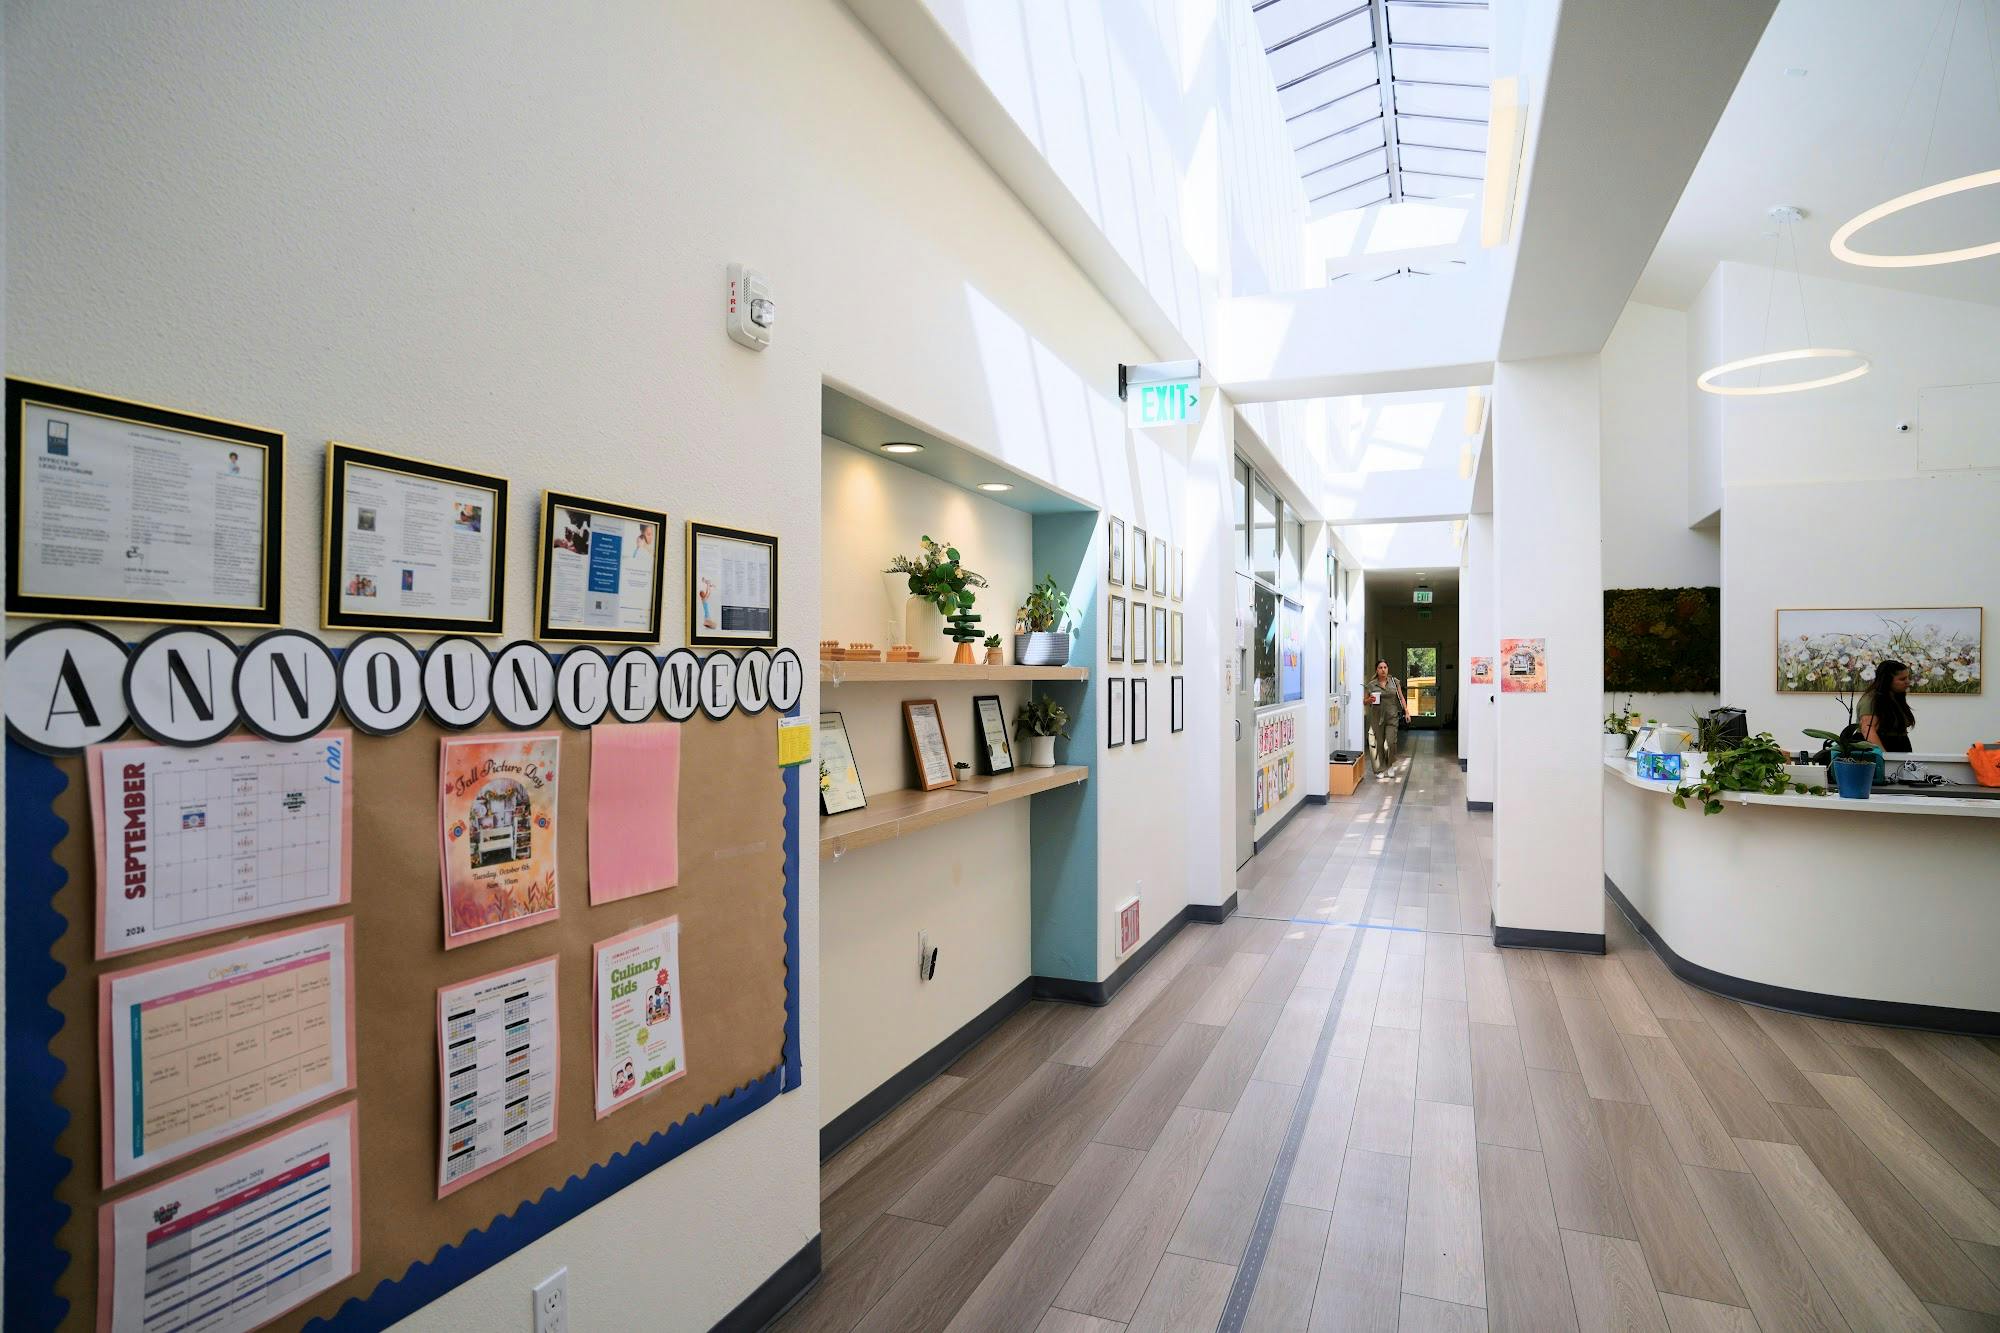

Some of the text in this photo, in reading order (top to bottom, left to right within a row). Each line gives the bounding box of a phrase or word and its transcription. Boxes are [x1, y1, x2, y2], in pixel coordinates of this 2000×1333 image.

[1141, 383, 1189, 422] EXIT
[1416, 592, 1430, 602] EXIT
[455, 758, 545, 797] Fall Picture Day
[123, 761, 147, 900] SEPTEMBER
[611, 956, 661, 984] Culinary
[610, 979, 638, 1001] Kids
